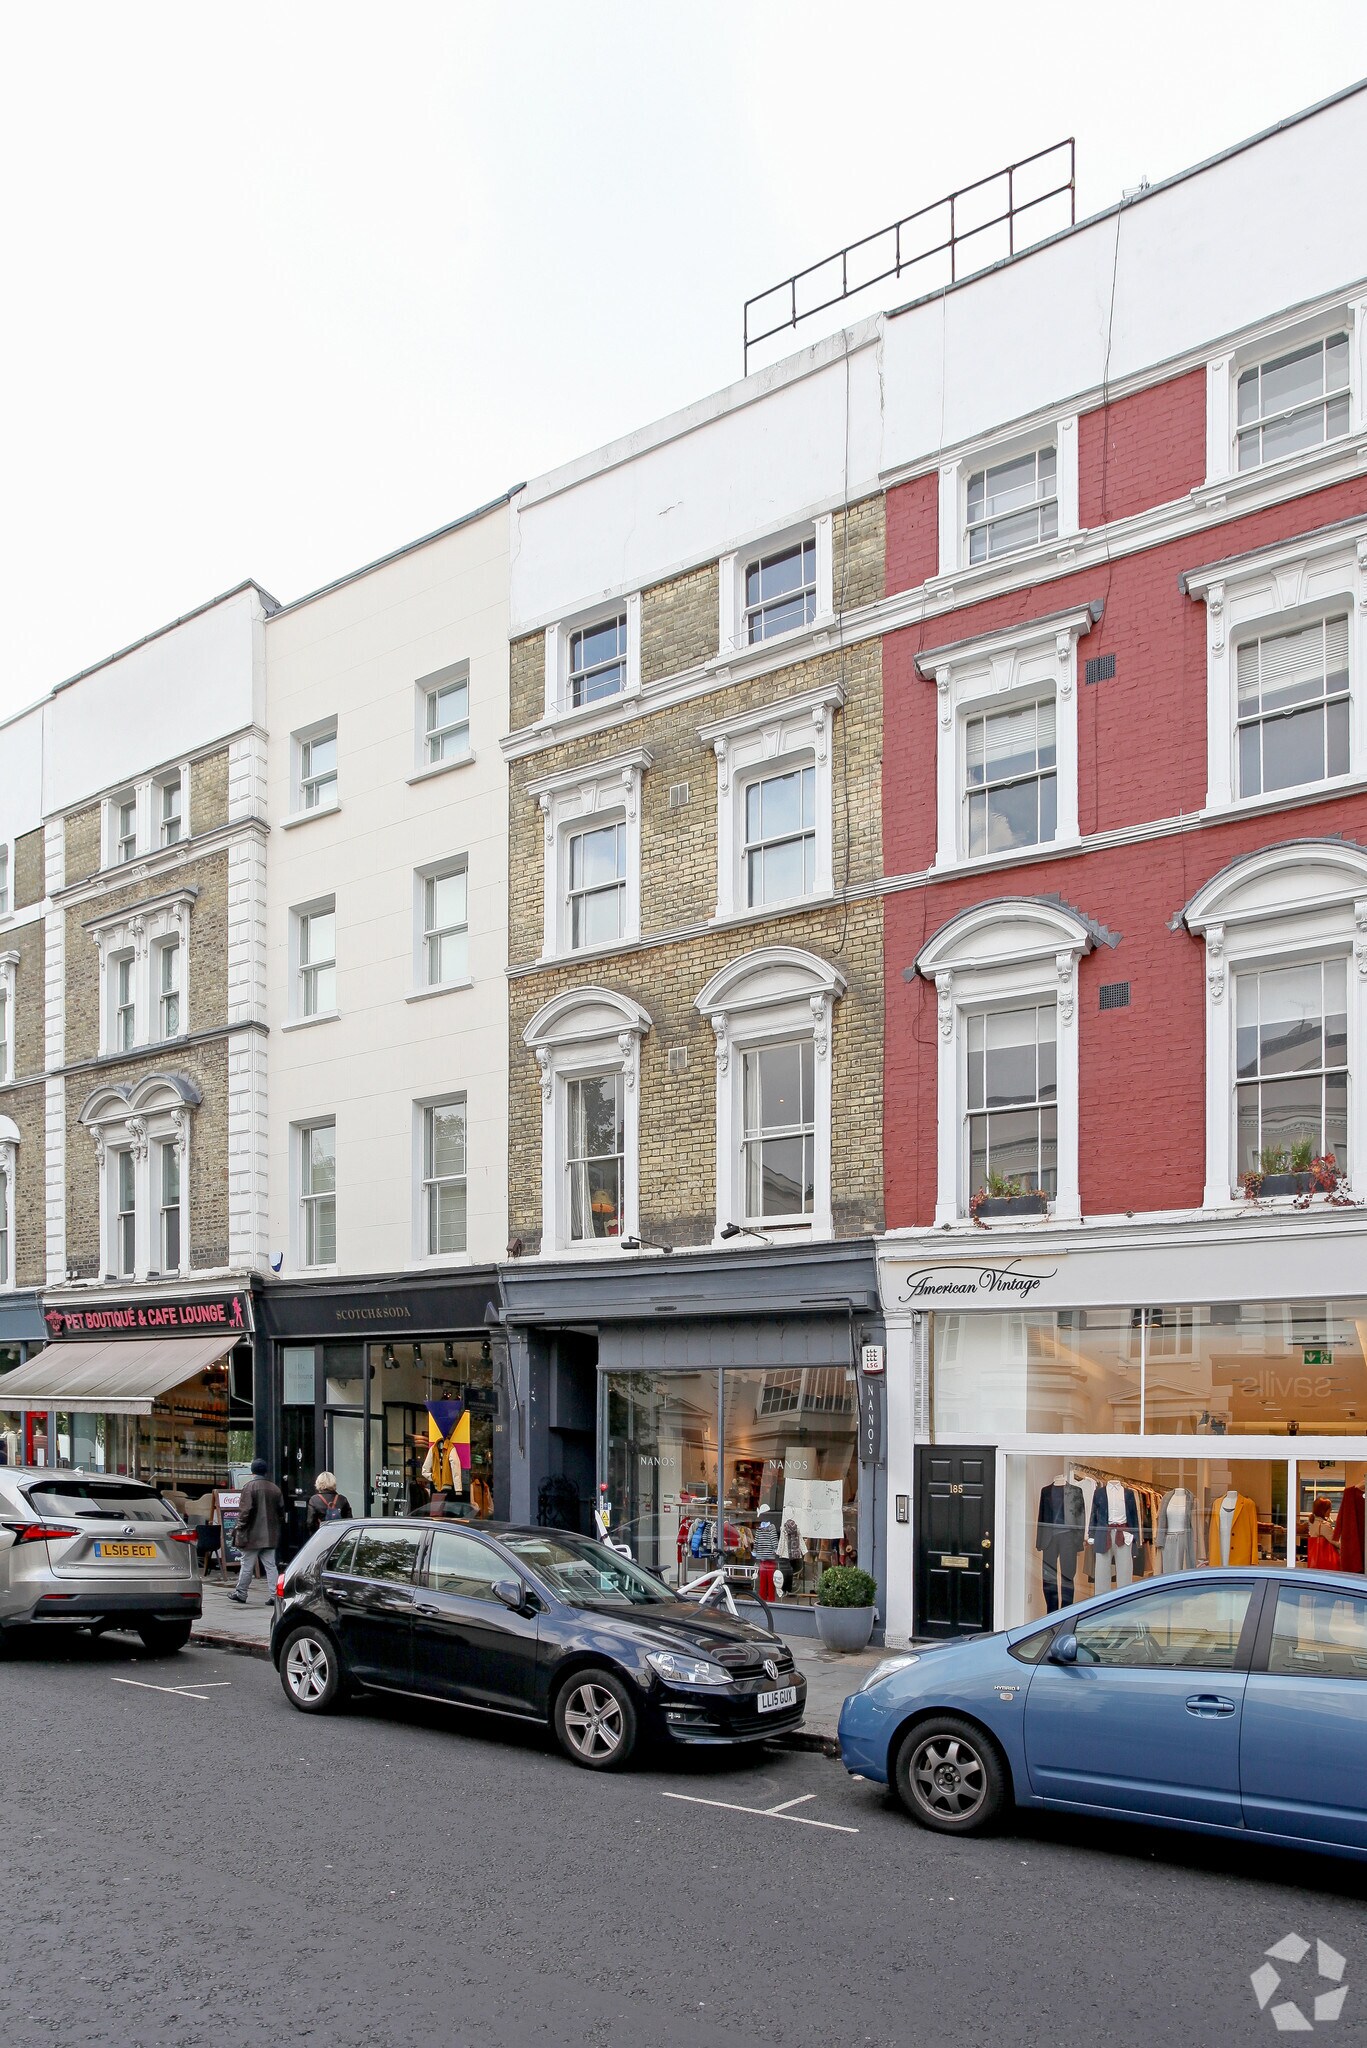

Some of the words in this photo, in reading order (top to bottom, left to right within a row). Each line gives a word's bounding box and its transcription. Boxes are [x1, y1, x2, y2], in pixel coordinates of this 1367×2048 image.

[898, 1275, 978, 1302] American
[978, 1259, 1041, 1299] Vintage
[65, 1313, 85, 1330] PET
[86, 1306, 136, 1329] BOUTIQUÉ
[138, 1312, 146, 1326] &
[148, 1306, 178, 1325] CAFE
[179, 1303, 227, 1325] LOUNGE
[336, 1306, 411, 1320] SCOTCH&SODA
[867, 1384, 875, 1455] NANOS
[640, 1456, 675, 1466] NANOS
[769, 1459, 809, 1470] NANOS
[949, 1484, 963, 1494] 185
[104, 1544, 130, 1556] LS15
[132, 1545, 152, 1556] ECT
[762, 1692, 779, 1709] LL15
[779, 1689, 793, 1704] GUX
